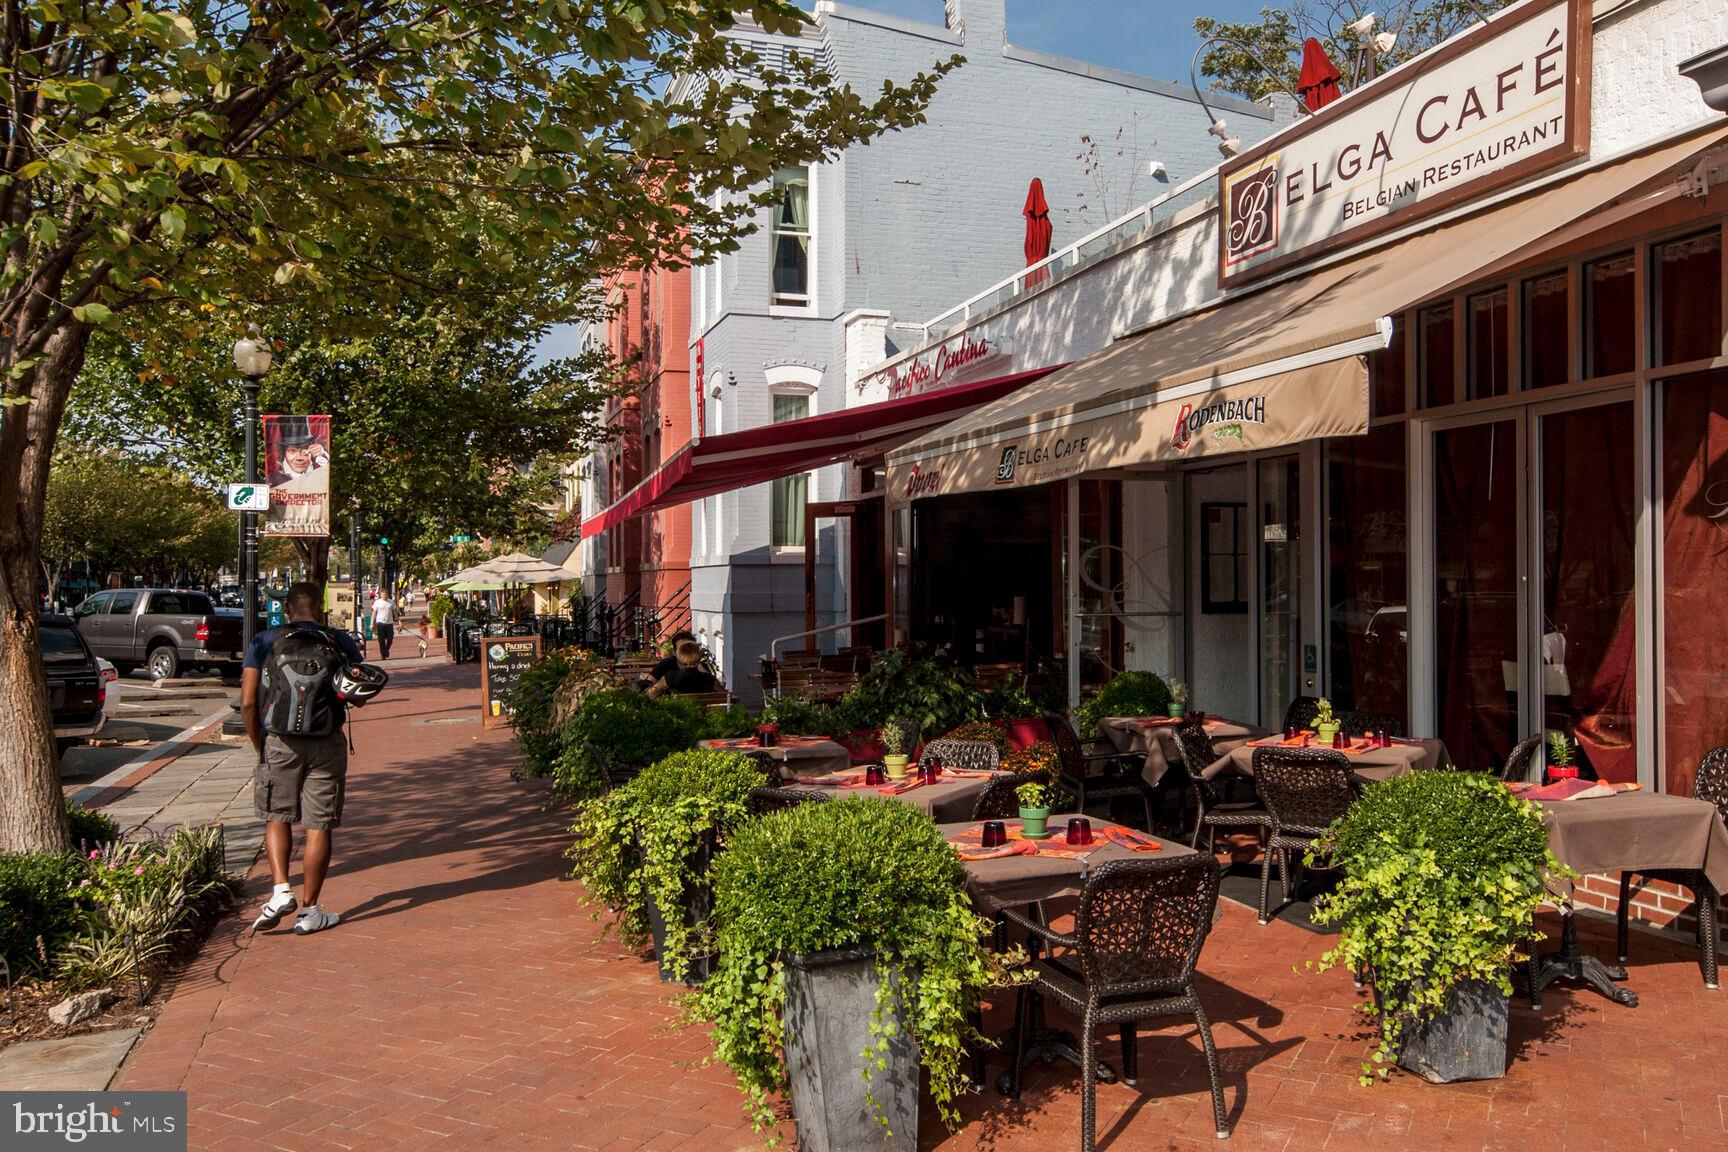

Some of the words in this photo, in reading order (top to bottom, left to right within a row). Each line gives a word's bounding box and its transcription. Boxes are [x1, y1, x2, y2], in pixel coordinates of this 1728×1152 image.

[1415, 28, 1564, 144] CAFÉ
[1342, 177, 1418, 222] BELGIAN
[1422, 115, 1563, 190] RESTAURANT
[887, 356, 931, 395] Pacifico
[935, 329, 989, 384] Cantina
[1170, 396, 1266, 451] RODENBACH
[269, 492, 328, 500] GOVERNMENT
[271, 600, 281, 611] P
